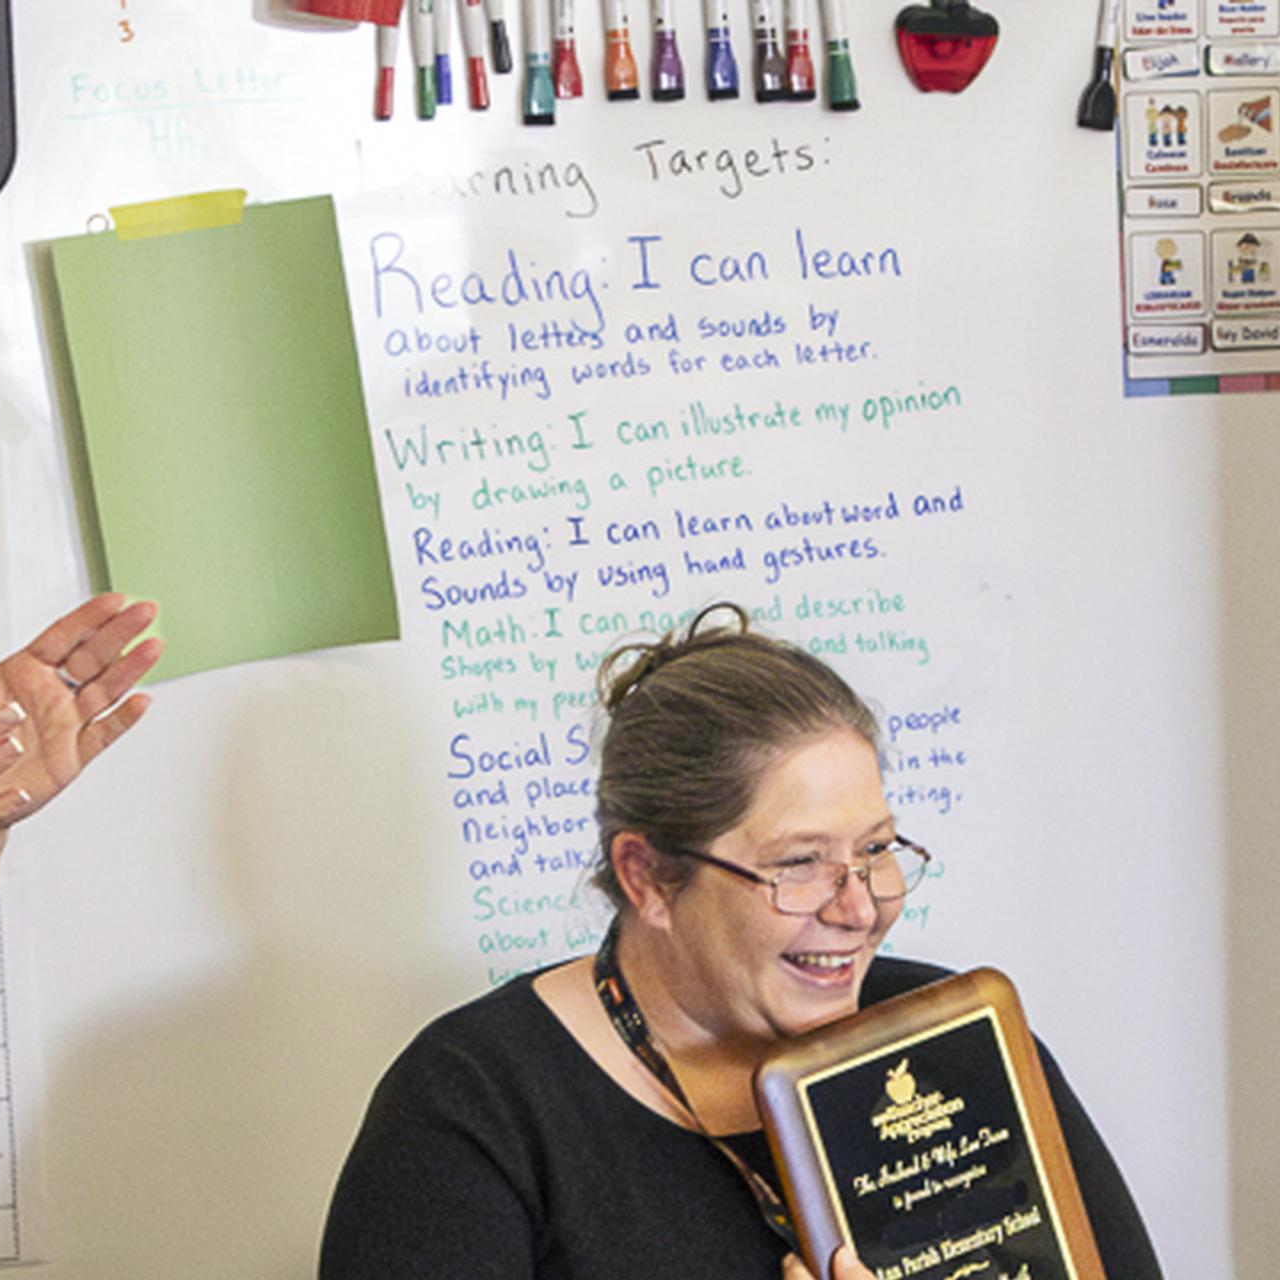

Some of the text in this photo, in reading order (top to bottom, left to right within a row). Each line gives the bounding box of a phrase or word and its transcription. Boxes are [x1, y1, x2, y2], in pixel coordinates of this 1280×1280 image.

[69, 73, 170, 103] Focus
[355, 136, 831, 218] Lrning Targets:
[370, 227, 902, 336] Reading: I can learn
[384, 303, 840, 357] about letters and sounds by
[404, 340, 878, 400] identifying words for each letter.
[384, 379, 962, 473] Writing: I can illustrate my opinion
[405, 453, 754, 521] by drawing a picture.
[412, 526, 552, 573] Reading:
[565, 515, 590, 546] I
[605, 519, 661, 545] can
[674, 509, 754, 539] learn
[912, 484, 965, 517] and
[420, 536, 887, 611] Sounds by using hand gestures.
[543, 606, 564, 639] I
[578, 609, 629, 636] can
[638, 606, 700, 634] nam
[746, 594, 783, 623] nd
[795, 587, 907, 622] describe
[528, 651, 557, 683] by
[807, 633, 849, 655] and
[853, 630, 931, 667] talking
[453, 691, 504, 719] with
[514, 697, 538, 721] my
[447, 731, 551, 779] Social
[888, 704, 962, 742] people
[452, 748, 967, 810] and place in the
[469, 854, 523, 881] and
[477, 927, 549, 954] about
[901, 1246, 941, 1277] Parish
[939, 1223, 1003, 1261] Elementary
[1003, 1205, 1042, 1236] School
